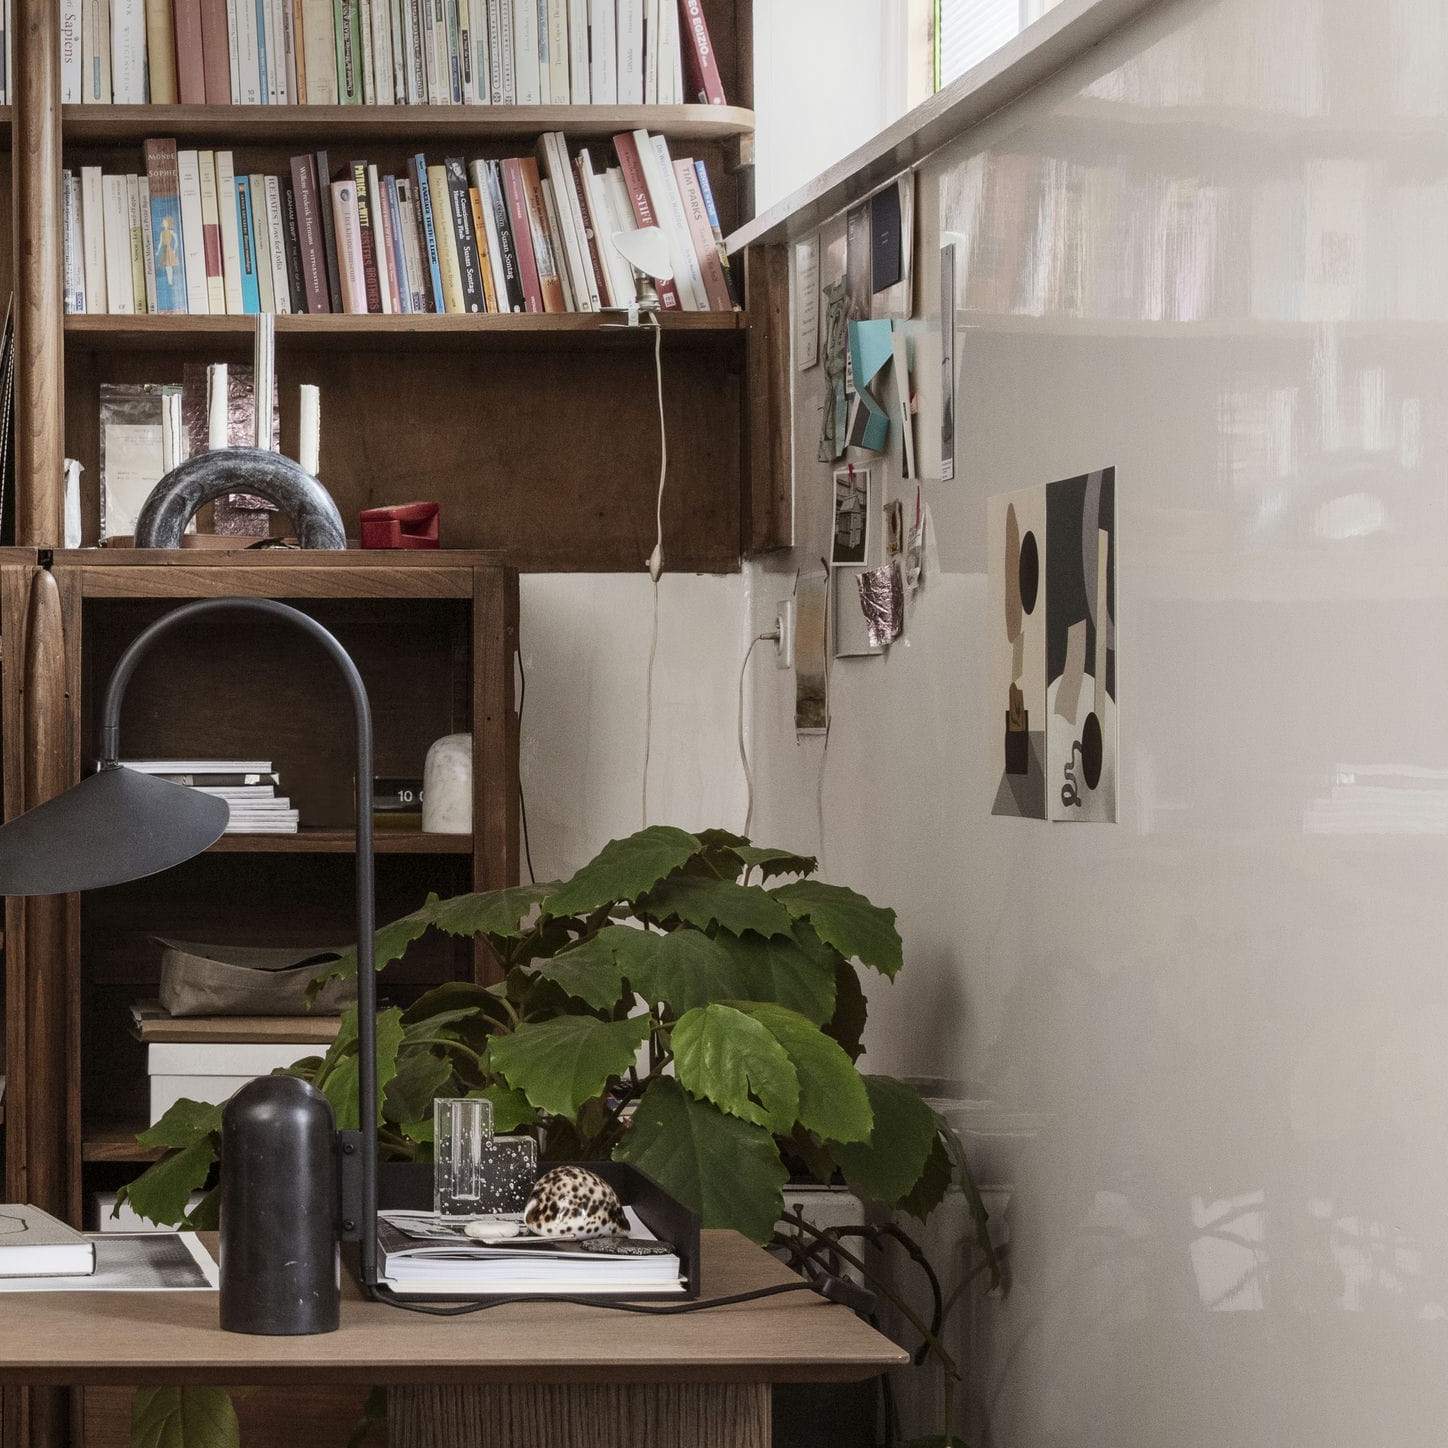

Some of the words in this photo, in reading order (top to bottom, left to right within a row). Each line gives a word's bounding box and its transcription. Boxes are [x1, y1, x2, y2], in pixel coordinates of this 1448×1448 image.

[61, 13, 76, 64] Sapiens
[692, 17, 709, 56] EGIZIO
[299, 166, 308, 189] Willem
[354, 165, 367, 196] PATRICK
[682, 166, 693, 186] TIM
[286, 189, 294, 220] GRAHAM
[302, 190, 312, 216] Frederik
[421, 182, 430, 215] LANGUAGE
[635, 193, 652, 225] STIFF
[687, 189, 701, 221] PARKS
[289, 221, 297, 242] SWIFT
[305, 217, 315, 245] Hermans
[500, 230, 510, 252] Susan
[361, 230, 372, 265] SISTERS
[463, 246, 472, 268] Susan
[504, 253, 514, 280] Sontag
[366, 267, 380, 310] BROTHERS
[465, 268, 476, 294] Sontag
[397, 790, 413, 802] 10
